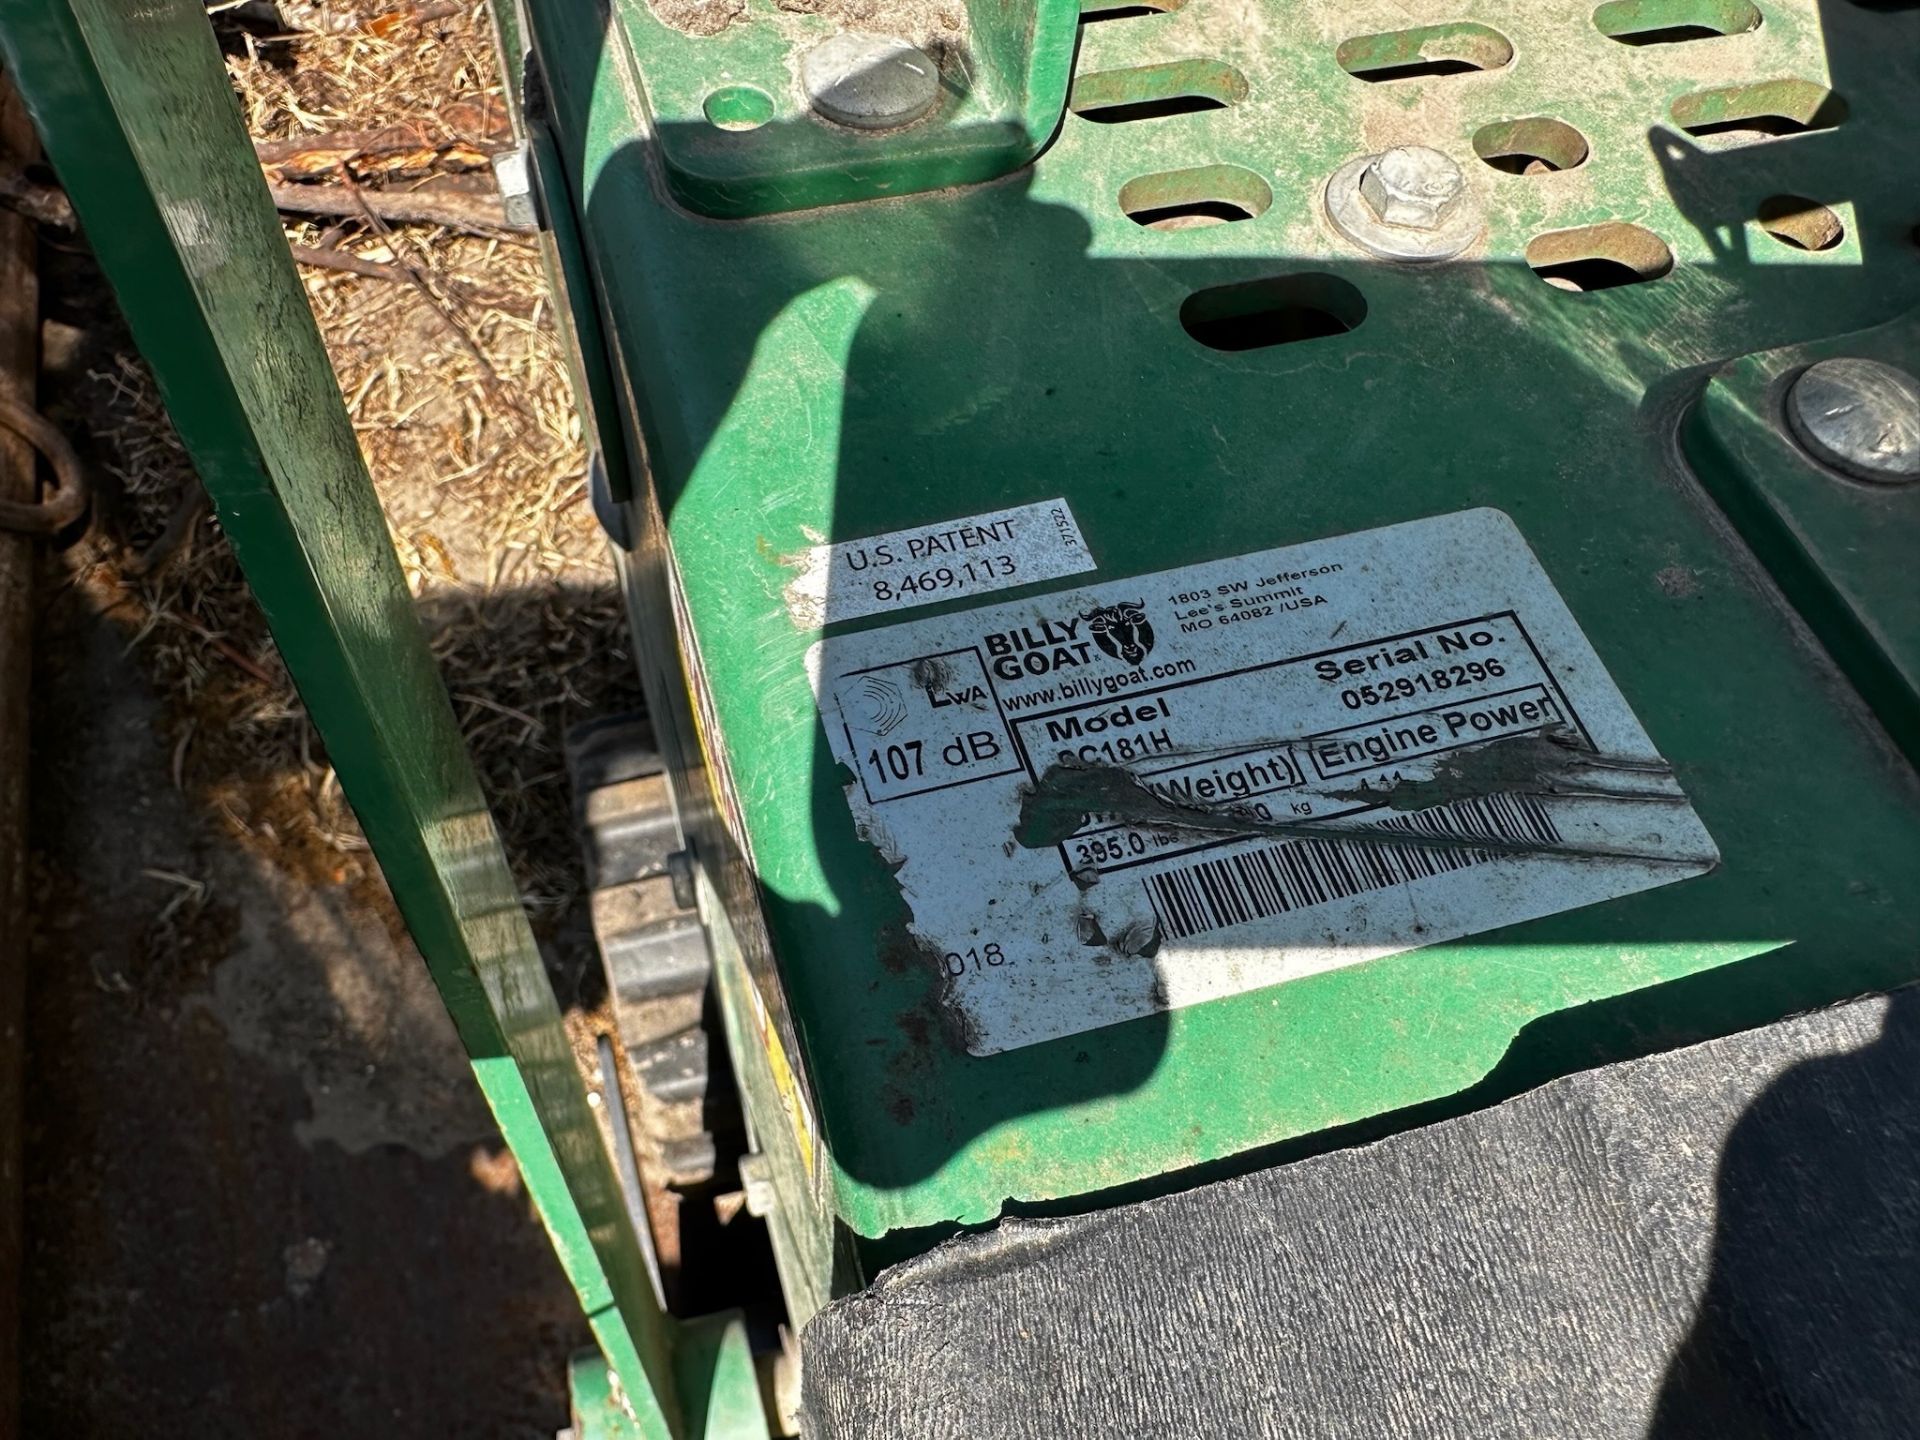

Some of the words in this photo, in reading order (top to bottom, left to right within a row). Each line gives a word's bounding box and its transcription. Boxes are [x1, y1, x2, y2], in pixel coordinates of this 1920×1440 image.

[846, 544, 903, 572] U.S.
[907, 518, 1015, 560] PATENT
[1050, 507, 1078, 547] 371522
[873, 554, 1017, 601] 8,469,113
[1168, 588, 1212, 606] 1803
[1217, 580, 1249, 596] SW
[1255, 562, 1344, 588] Jefferson
[1174, 603, 1225, 621] Lee's
[1230, 586, 1304, 609] Summit
[1180, 618, 1213, 634] MO
[1218, 606, 1274, 626] 64082
[1279, 594, 1329, 613] /USA
[984, 617, 1079, 656] BILLY
[1314, 640, 1430, 681] Serial
[1436, 631, 1506, 654] No.
[993, 641, 1091, 681] GOAT
[1002, 658, 1197, 712] www.billygoat.com
[1341, 657, 1506, 710] 052918296
[1045, 697, 1171, 742] Model
[1318, 724, 1439, 768] Engine
[1442, 694, 1551, 738] Power
[868, 740, 924, 784] 107
[942, 731, 1001, 766] dB
[1290, 801, 1313, 816] kg
[1076, 831, 1146, 866] 395.0
